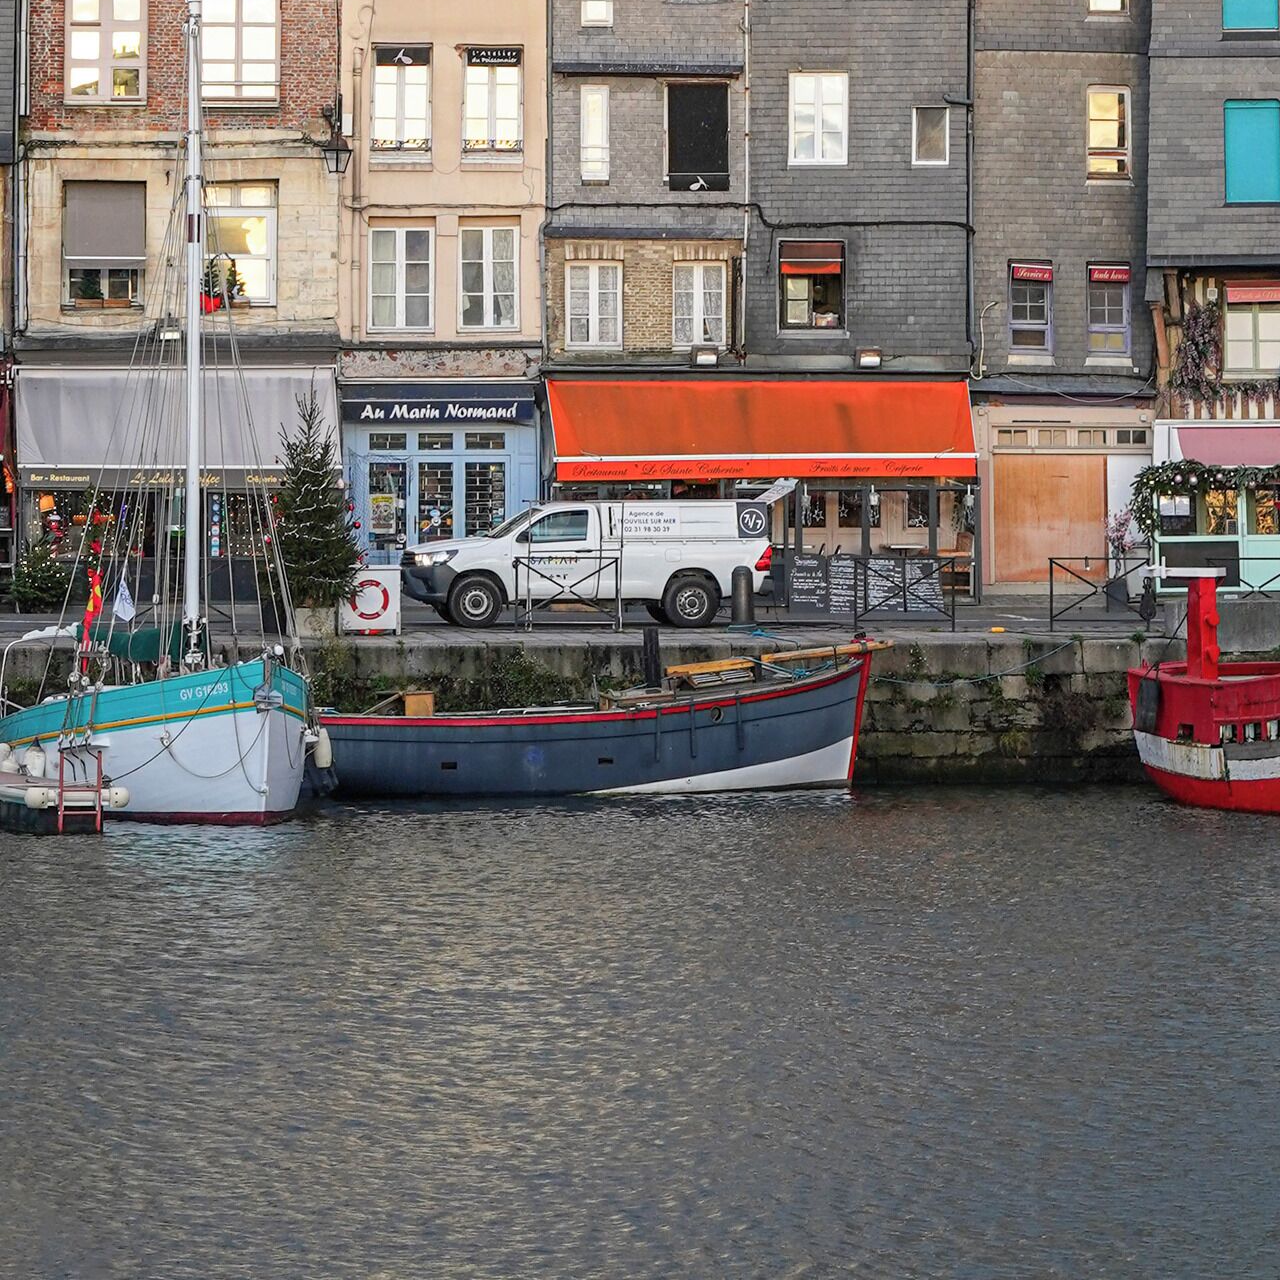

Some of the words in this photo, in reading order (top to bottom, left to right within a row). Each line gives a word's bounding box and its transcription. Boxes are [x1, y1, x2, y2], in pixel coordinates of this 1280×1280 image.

[360, 404, 385, 419] Au
[389, 404, 440, 419] Marin
[444, 402, 518, 419] Normand
[30, 473, 43, 482] Bar
[50, 473, 90, 482] Restaurant
[180, 688, 193, 700] GV
